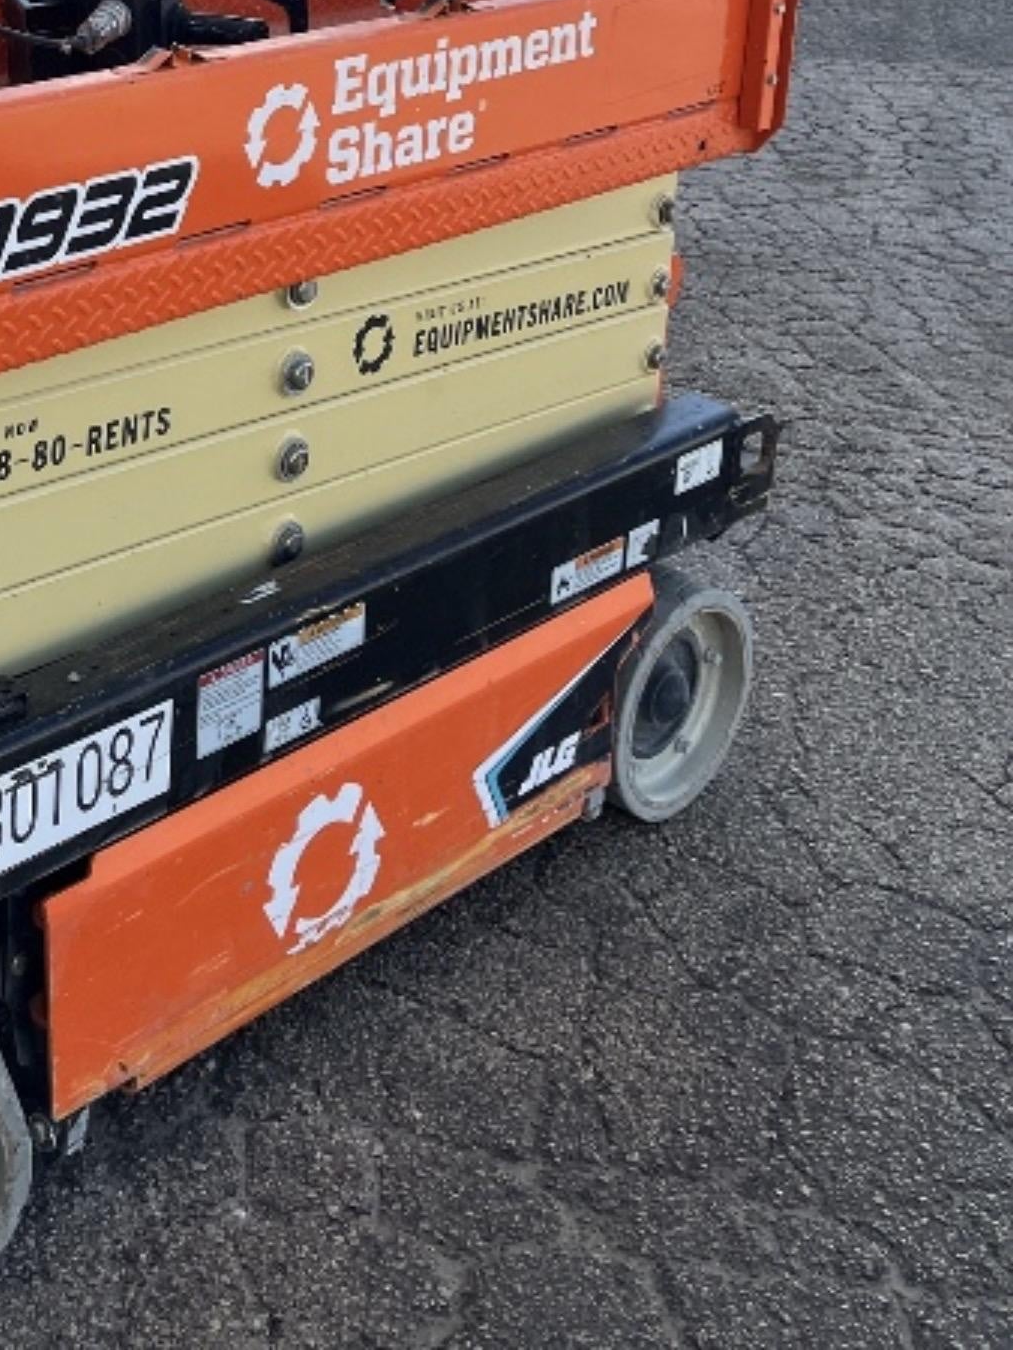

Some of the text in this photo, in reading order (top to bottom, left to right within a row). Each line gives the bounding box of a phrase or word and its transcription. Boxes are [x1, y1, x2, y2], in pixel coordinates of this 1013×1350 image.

[331, 11, 598, 118] Equipment
[325, 109, 477, 186] Share
[412, 279, 631, 358] EQUIPMENTSHARE.COM
[517, 729, 582, 797] JLG
